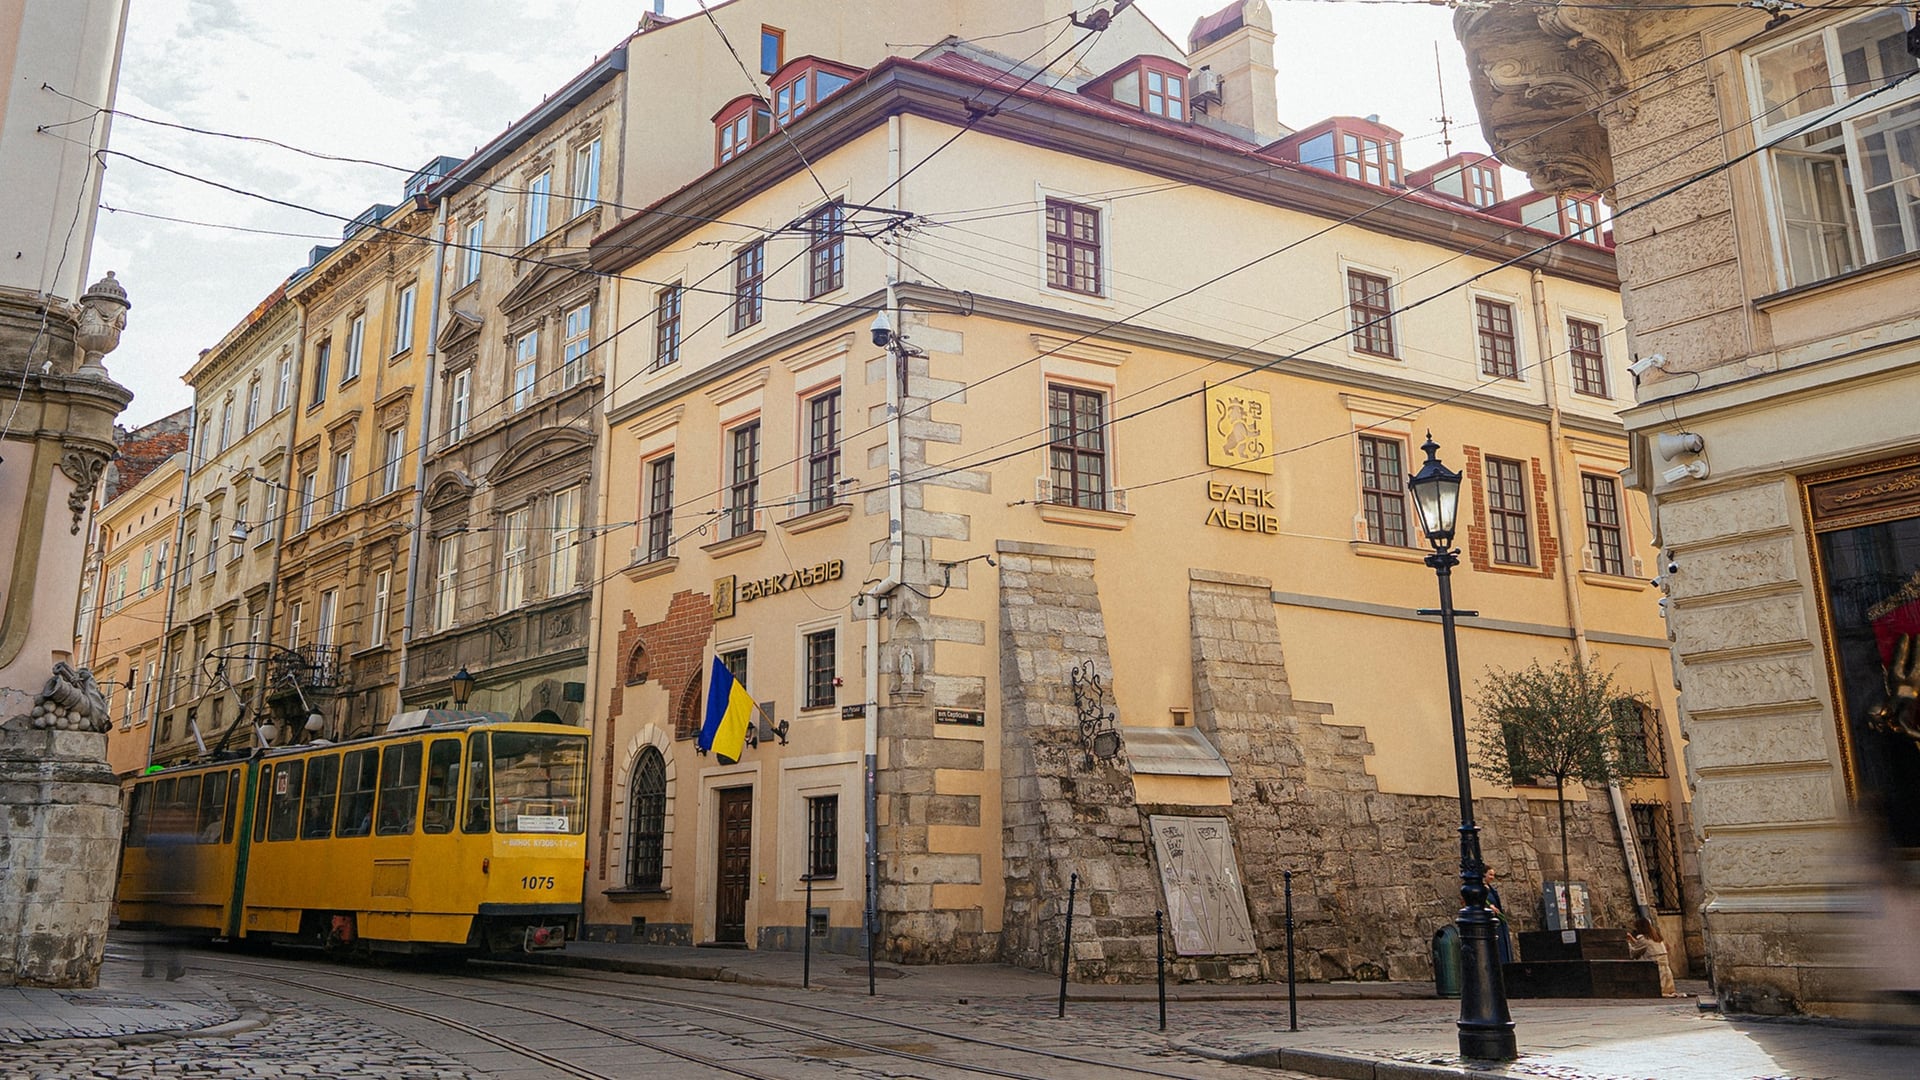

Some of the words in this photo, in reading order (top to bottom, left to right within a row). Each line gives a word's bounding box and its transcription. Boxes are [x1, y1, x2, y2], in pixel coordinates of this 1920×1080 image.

[1208, 481, 1276, 508] БАНК
[1205, 507, 1280, 534] ЛЬВІВ
[741, 574, 787, 602] БАНК
[789, 559, 843, 590] ЛЬВІВ
[558, 818, 565, 830] 2
[521, 876, 555, 890] 1075
